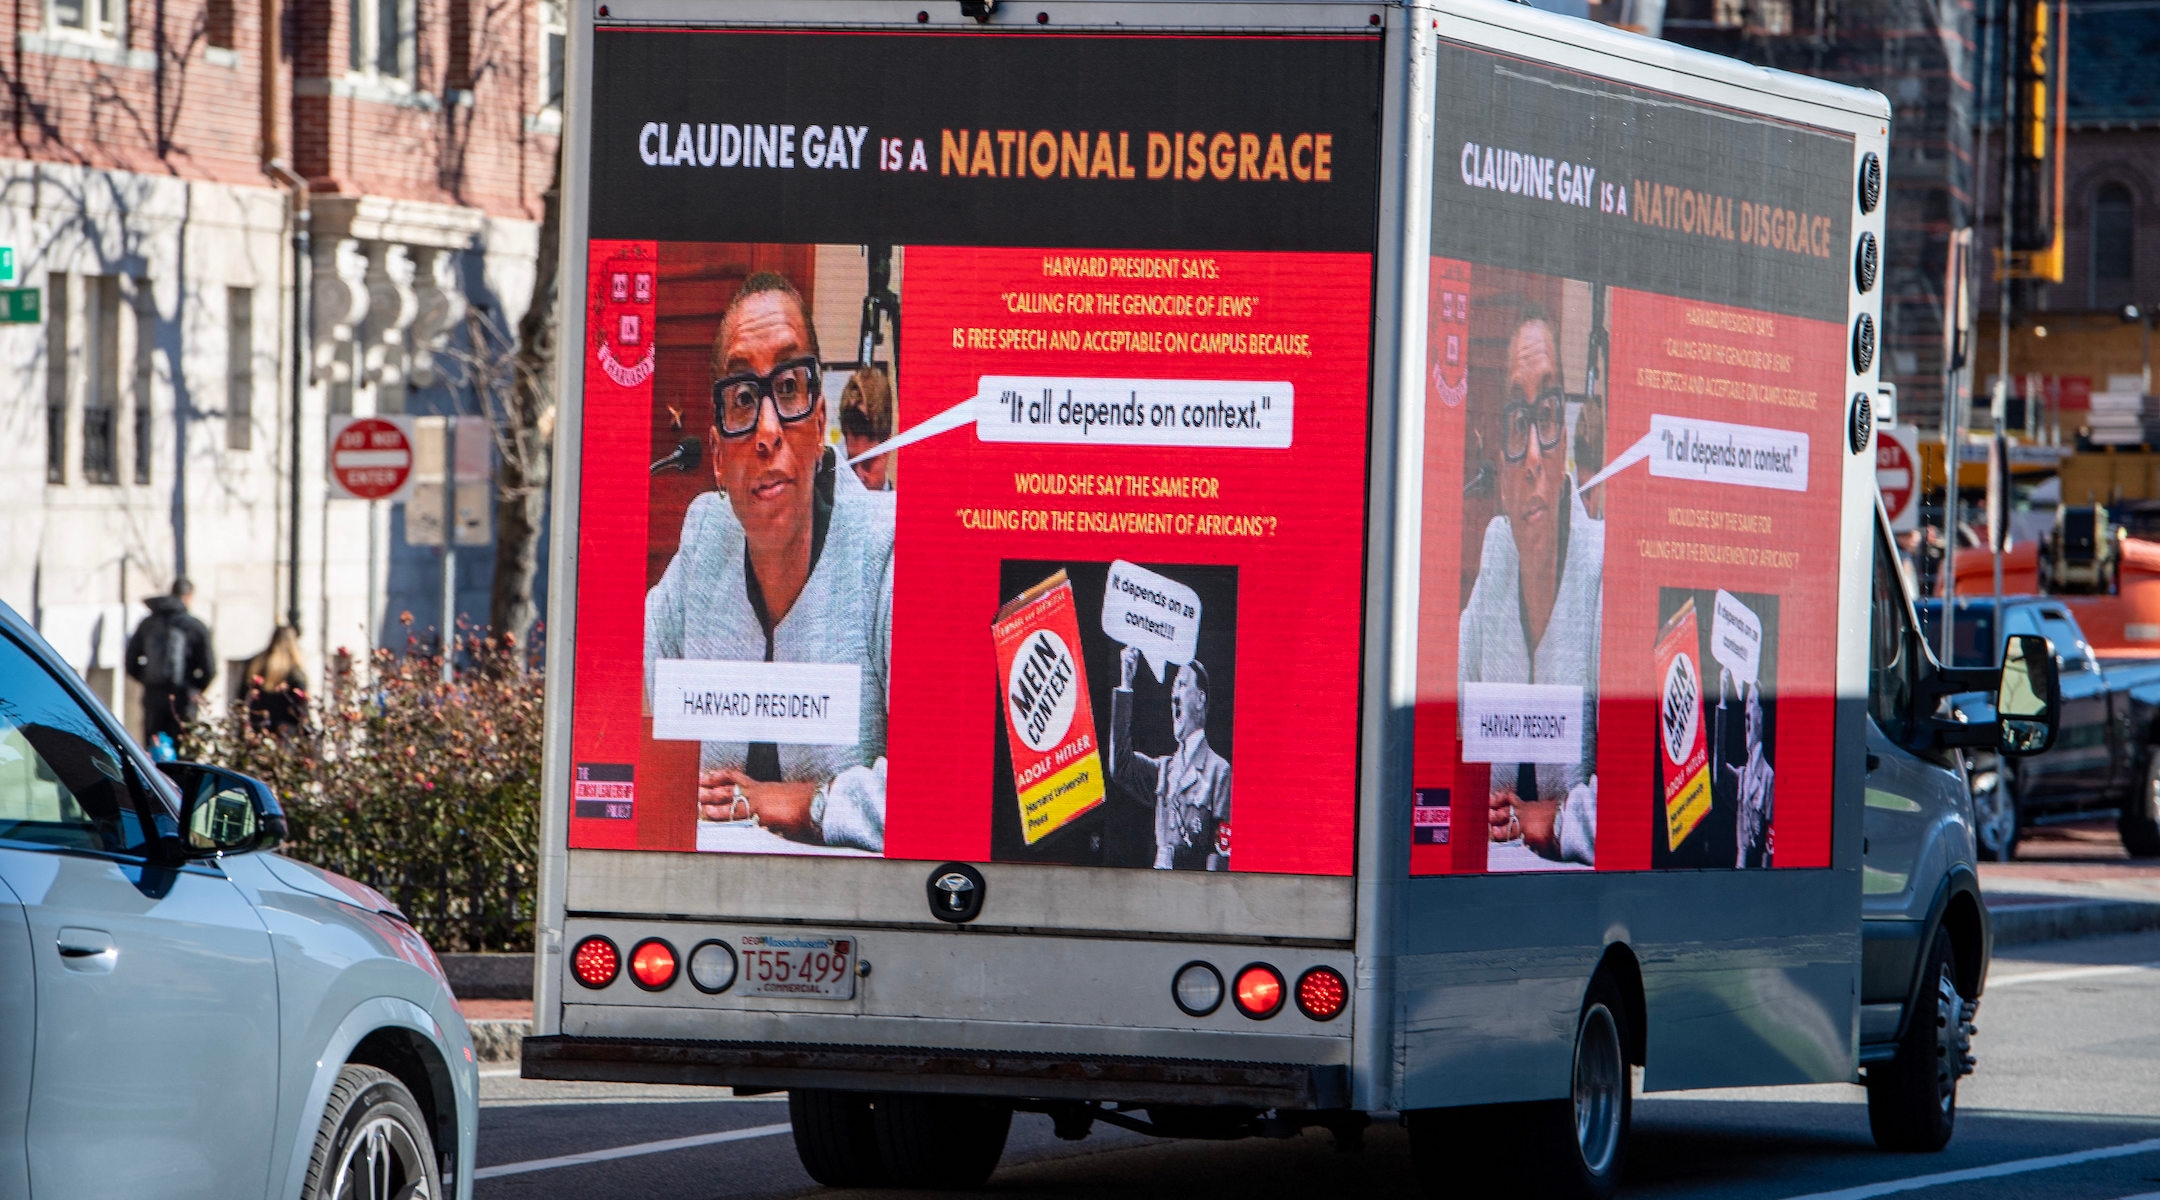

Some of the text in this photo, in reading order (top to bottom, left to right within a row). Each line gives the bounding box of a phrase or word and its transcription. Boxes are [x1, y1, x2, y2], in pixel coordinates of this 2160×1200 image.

[639, 122, 1333, 183] CLAUDINE GAY IS A NATIONAL DISGRACE
[1460, 141, 1832, 259] CLAUDINE GAY IS A NATIONAL DISGRACE
[1043, 256, 1220, 280] HARVARD PRESIDENT SAYS:
[1066, 293, 1094, 314] FOR
[1096, 294, 1121, 315] THE
[1122, 295, 1193, 317] GENOCIDE
[1195, 296, 1216, 317] OF
[952, 327, 1313, 358] IS FREE SPEECH AND ACCEPTABLE ON CAMPUS BECAUSE,
[1028, 389, 1053, 425] all
[1058, 389, 1145, 435] depends
[1150, 402, 1175, 428] on
[341, 431, 401, 448] DO NOT
[1676, 429, 1690, 462] all
[1691, 430, 1737, 474] depends
[1738, 446, 1752, 469] on
[347, 469, 397, 486] ENTER
[1014, 472, 1219, 499] WOULD SHE SAY THE SAME FOR
[1021, 509, 1049, 532] FOR
[1050, 510, 1075, 532] THE
[1078, 511, 1173, 535] ENSLAVEMENT
[1175, 512, 1196, 535] OF
[1121, 578, 1166, 608] depends
[1168, 598, 1182, 614] on
[1183, 604, 1195, 619] ze
[1011, 631, 1058, 721] MEIN
[683, 691, 830, 720] HARVARD PRESIDENT
[1027, 653, 1073, 746] CONTEXT
[1664, 654, 1688, 738] MEIN
[1480, 713, 1567, 739] HARVARD PRESIDENT
[1672, 674, 1696, 760] CONTEXT
[1018, 734, 1091, 786] ADOLF HITLER
[764, 936, 829, 950] Massachusetts
[763, 982, 822, 994] COMMERCIAL
